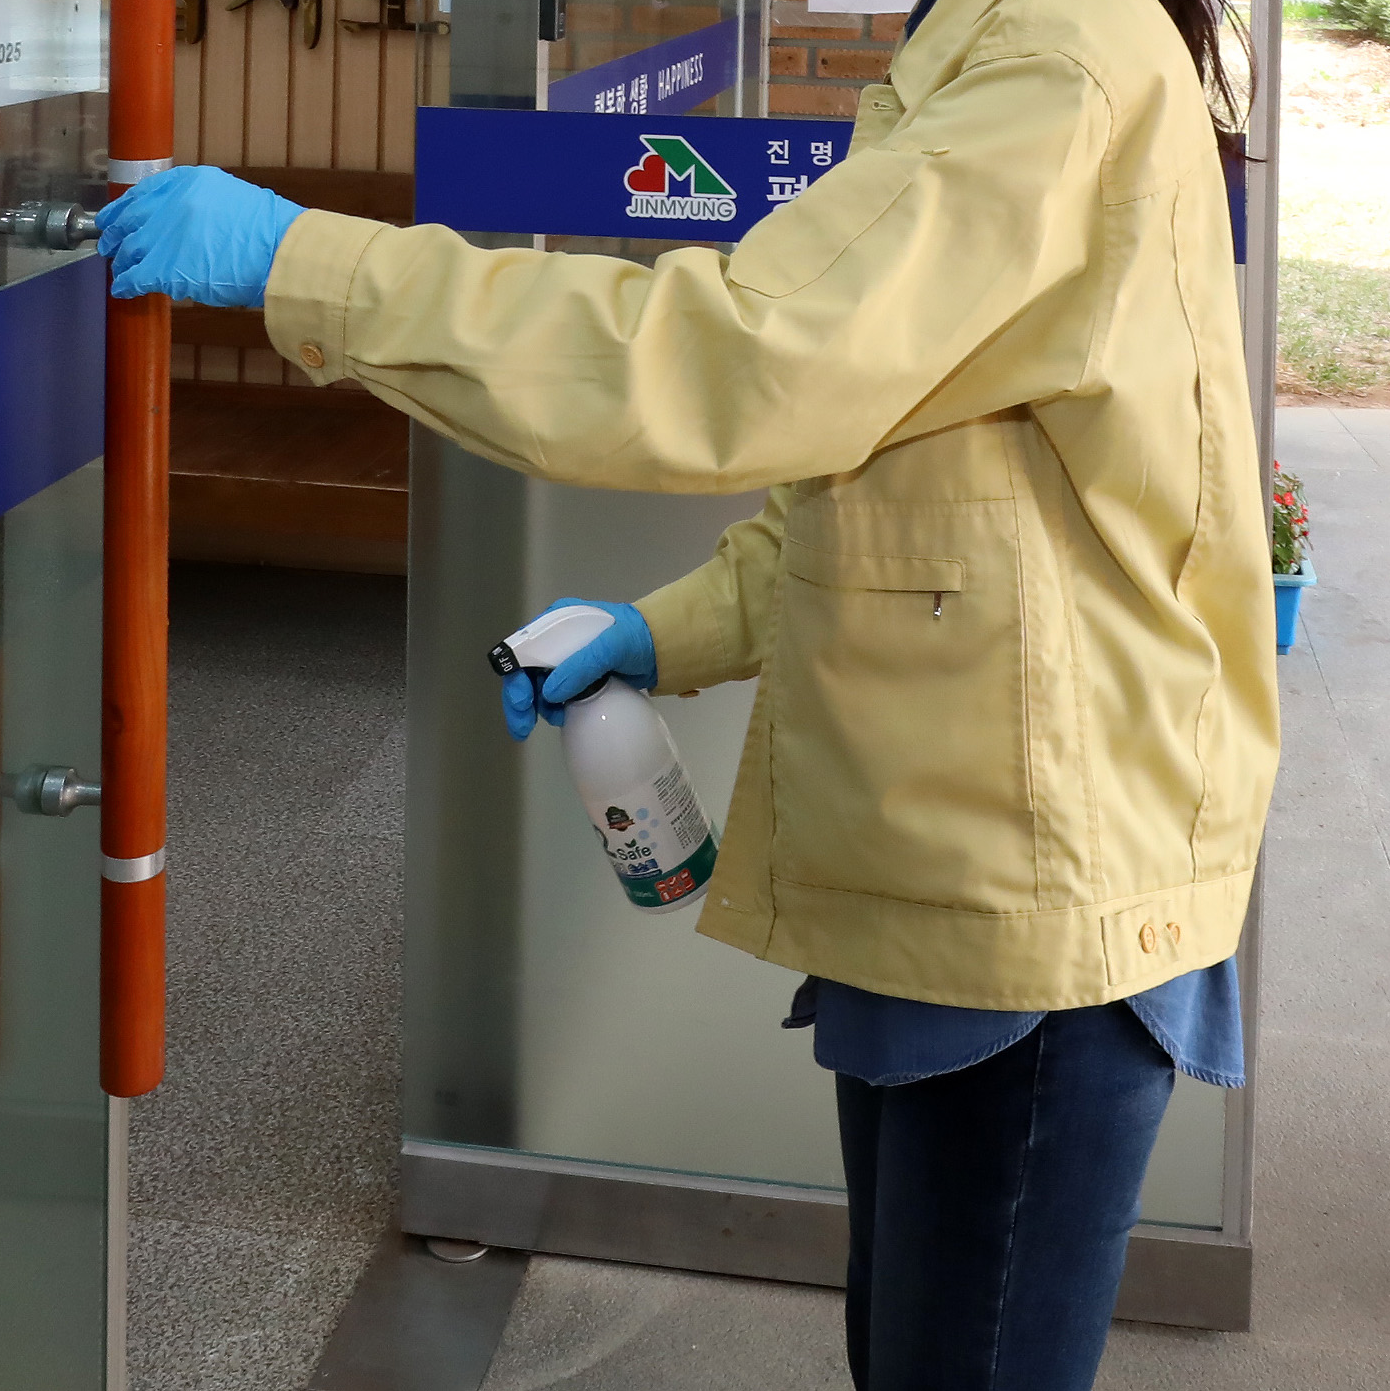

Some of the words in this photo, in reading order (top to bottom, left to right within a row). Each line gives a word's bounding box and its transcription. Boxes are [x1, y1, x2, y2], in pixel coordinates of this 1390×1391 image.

[657, 52, 704, 102] HAPPINESS
[629, 197, 734, 219] JINMYUNG
[617, 845, 652, 861] Safe
